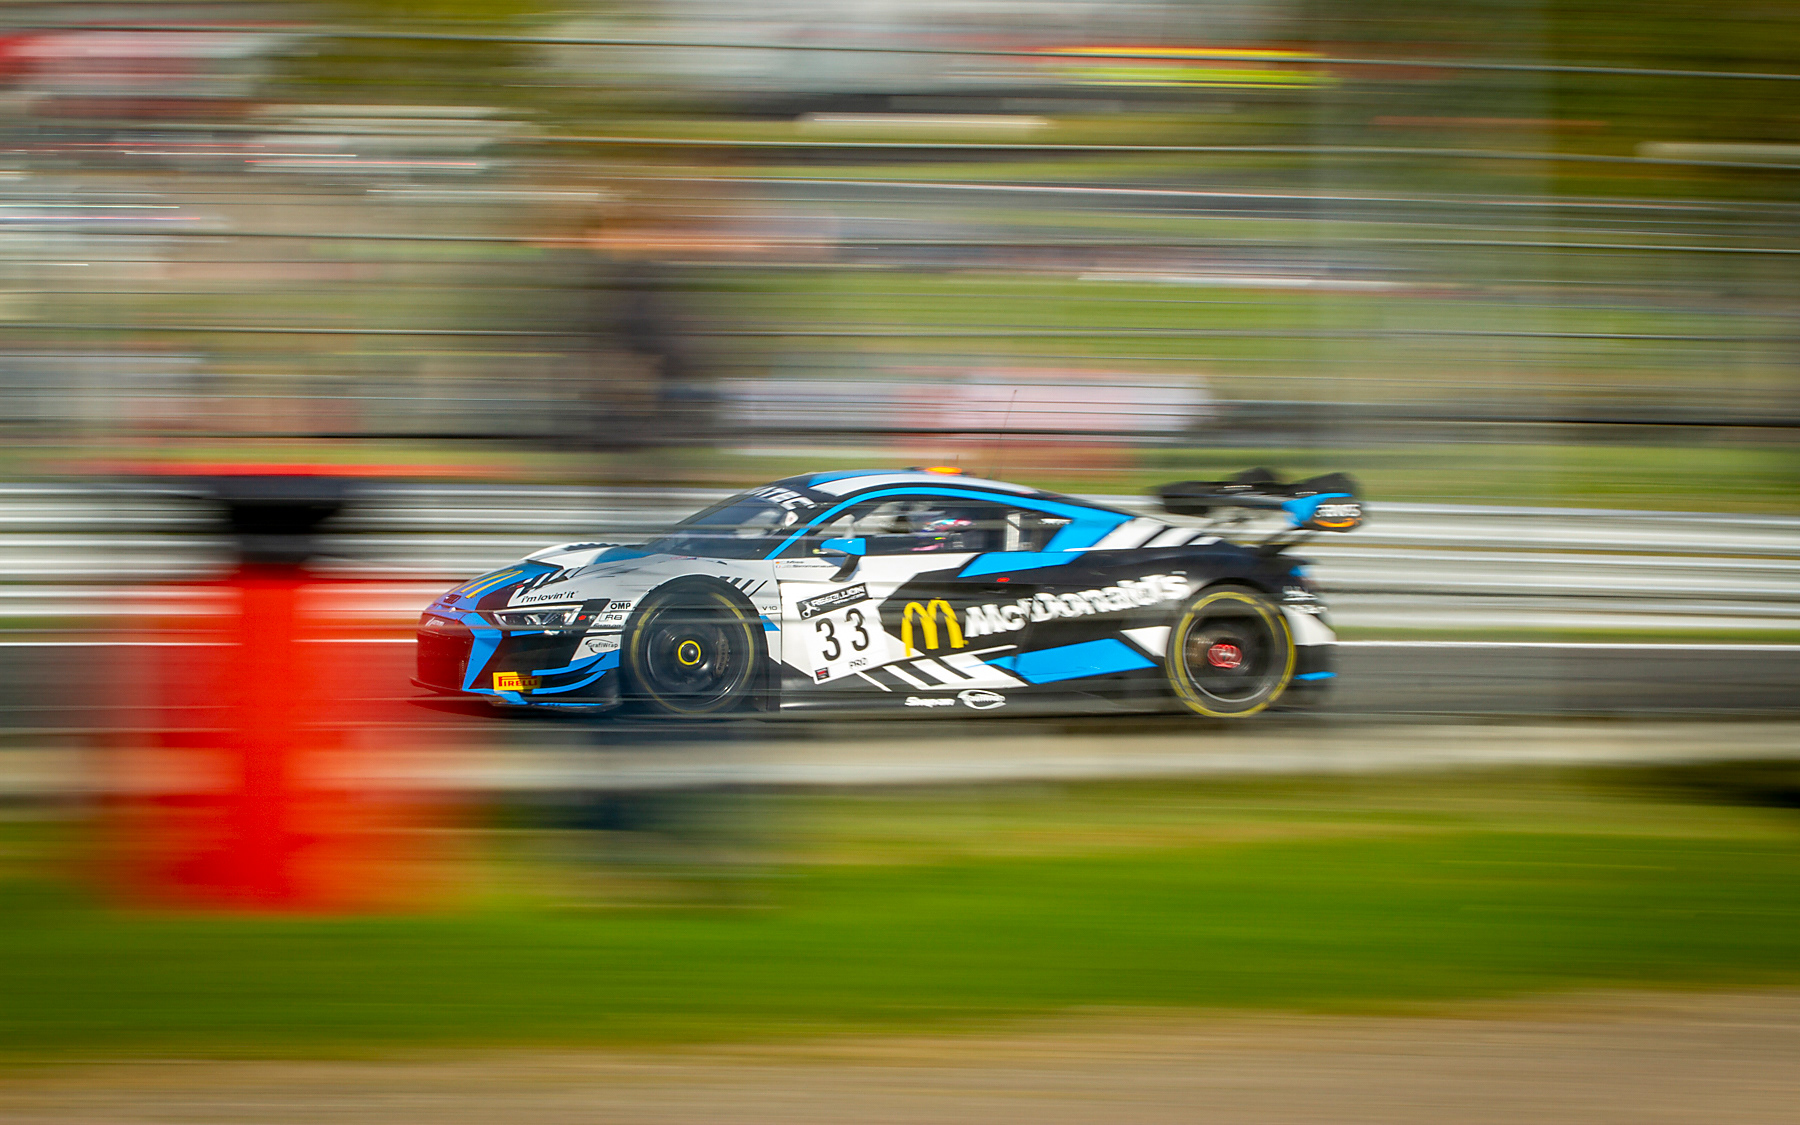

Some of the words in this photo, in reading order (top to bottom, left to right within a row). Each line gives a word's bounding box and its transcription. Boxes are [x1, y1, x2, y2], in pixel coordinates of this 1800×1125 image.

[521, 595, 537, 603] i'm
[538, 591, 567, 600] lovin'
[567, 591, 575, 599] it
[610, 602, 631, 610] OMP
[964, 573, 1192, 638] McDonald's
[815, 608, 869, 661] 33
[498, 676, 538, 687] PIRELLI
